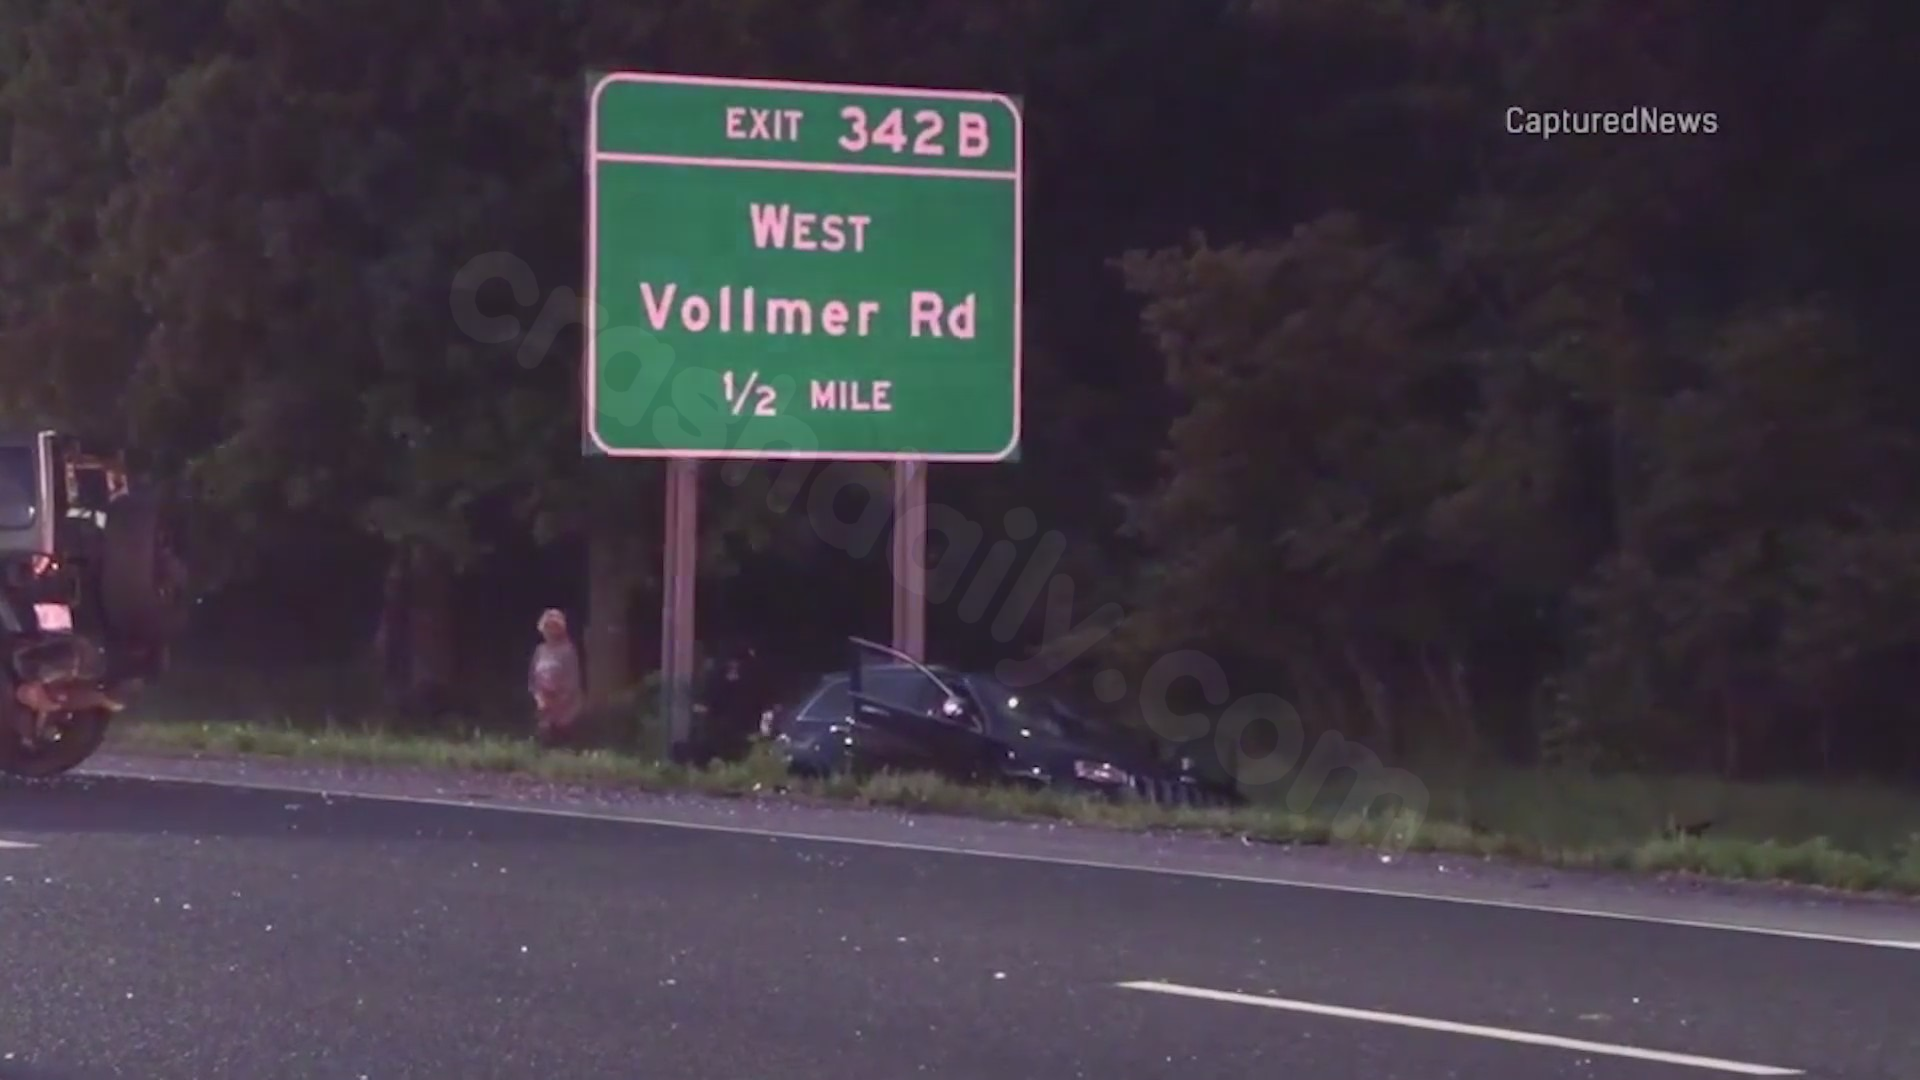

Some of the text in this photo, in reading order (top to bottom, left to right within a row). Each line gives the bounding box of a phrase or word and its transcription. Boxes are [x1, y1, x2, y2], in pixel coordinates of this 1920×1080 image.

[726, 106, 804, 142] EXIT
[750, 203, 871, 252] WEST
[639, 282, 976, 339] Vollmer Rd
[810, 380, 893, 412] MILE
